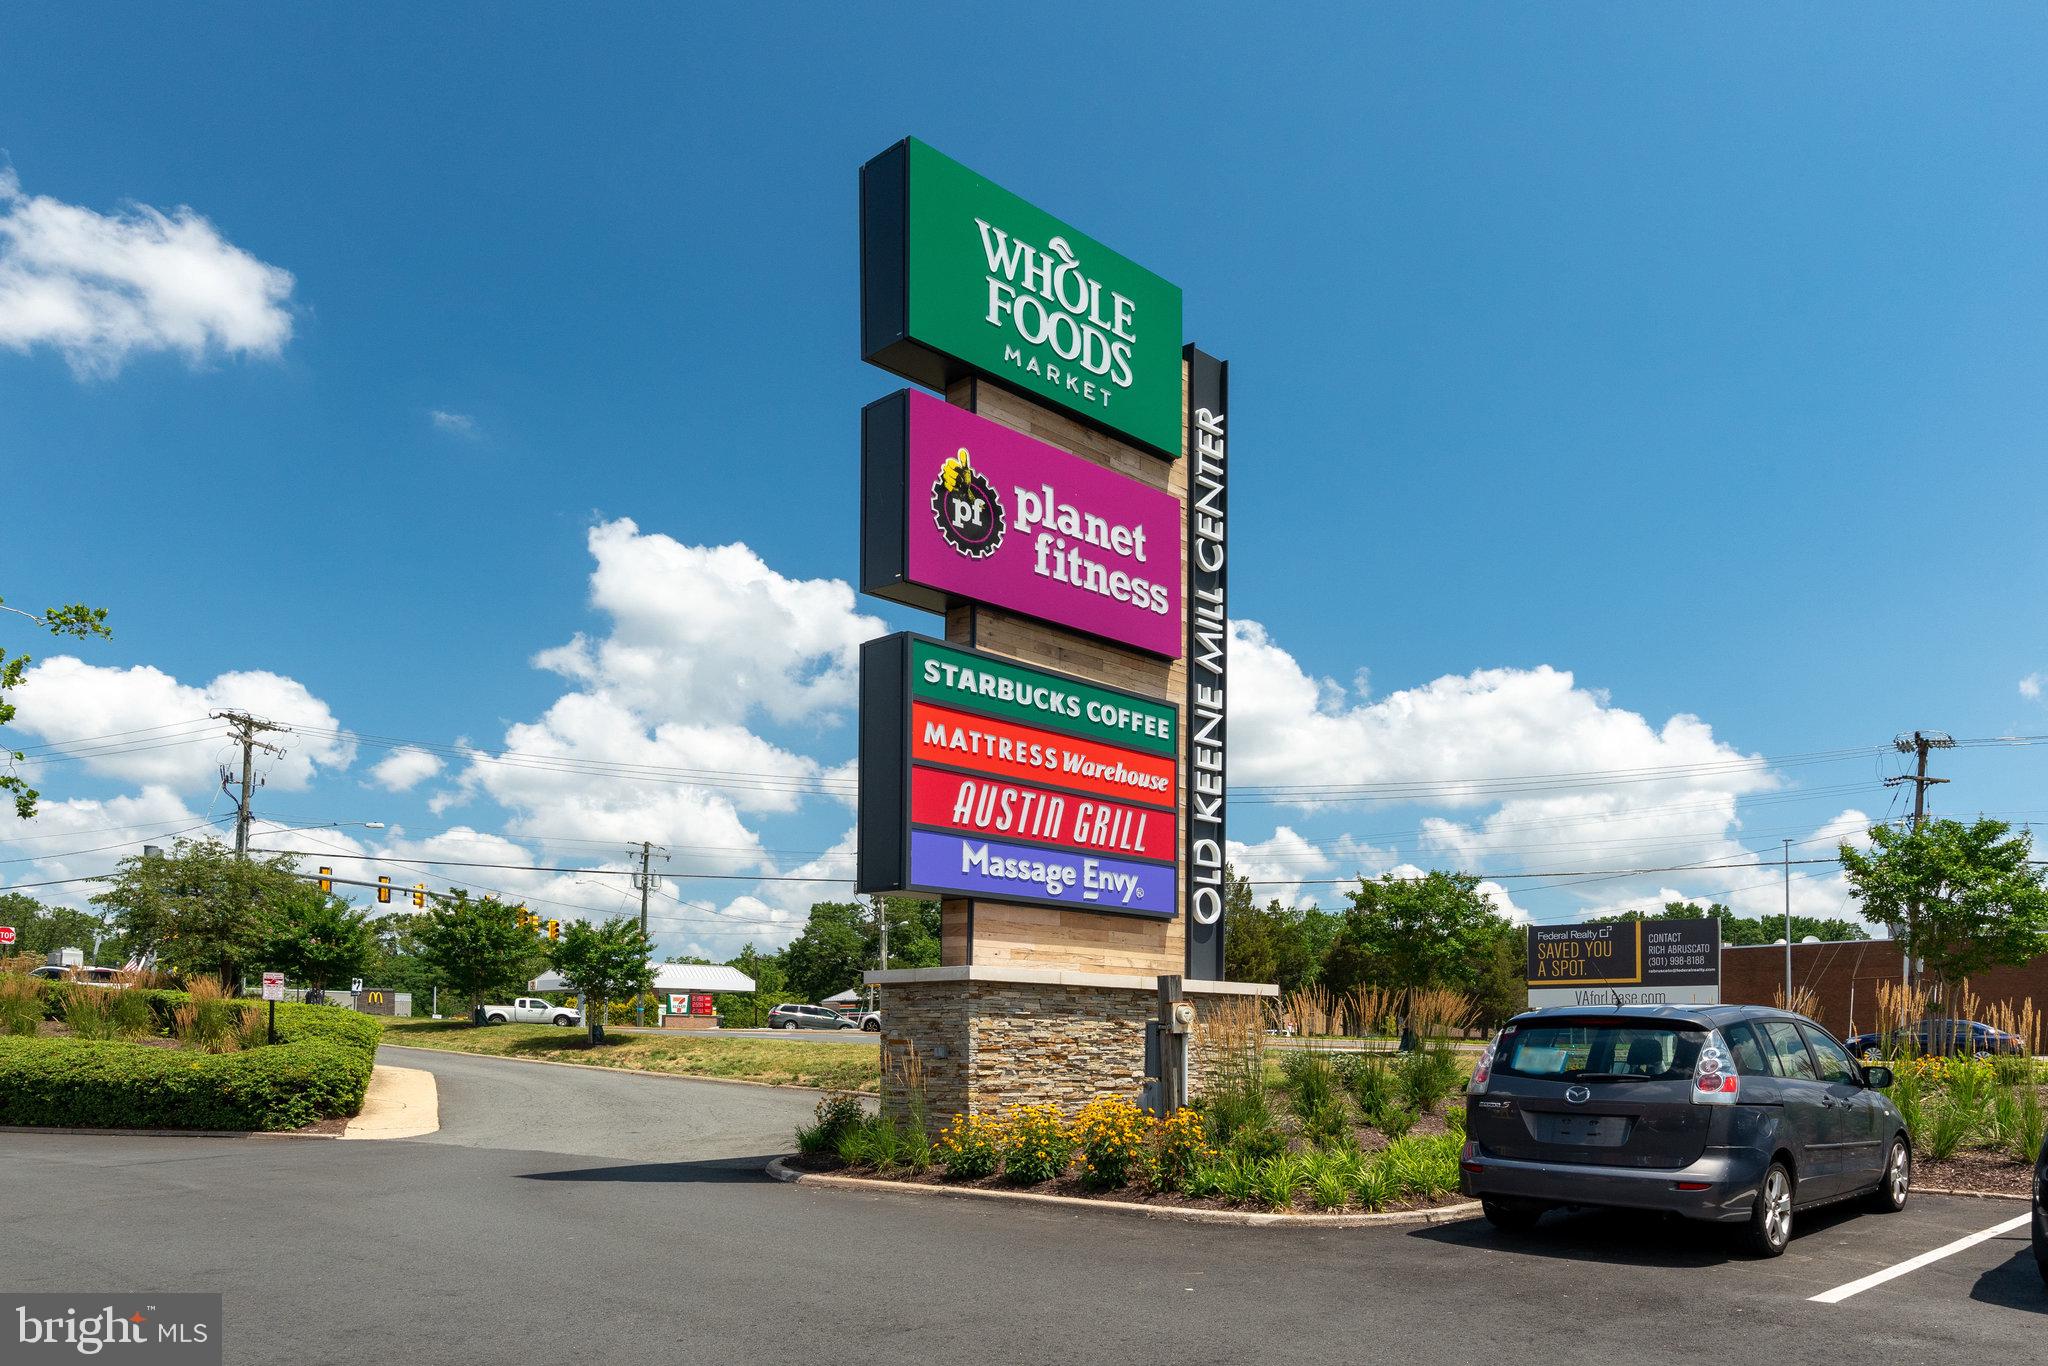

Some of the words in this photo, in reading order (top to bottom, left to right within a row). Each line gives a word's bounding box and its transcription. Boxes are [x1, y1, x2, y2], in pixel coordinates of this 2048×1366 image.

[975, 217, 1136, 343] WHOLE
[986, 276, 1133, 388] FOODS
[1004, 344, 1112, 407] MARKET
[952, 498, 986, 528] pf
[1014, 484, 1147, 562] planet
[1195, 407, 1225, 573] CENTER
[1034, 532, 1169, 615] fitness
[1195, 587, 1224, 674] MILL
[924, 659, 1080, 718] STARBUCKS
[1086, 701, 1170, 739] COFFEE
[923, 721, 1058, 769] MATTRESS
[1062, 750, 1169, 792] Warehouse
[1194, 683, 1223, 823] KEENE
[952, 781, 1065, 838] AUSTIN
[1074, 802, 1148, 852] GRILL
[962, 840, 1077, 895] Massage
[1193, 839, 1222, 925] OLD
[1538, 931, 1568, 940] Federal
[1570, 930, 1598, 940] Realty
[1538, 941, 1579, 960] SAVED
[1584, 940, 1612, 958] YOU
[1538, 960, 1546, 976] A
[1552, 960, 1587, 976] SPOT.
[1648, 932, 1682, 943] CONTACT
[1648, 946, 1666, 954] RICH
[1668, 944, 1710, 954] ABRUSCATO
[1648, 956, 1668, 967] (301)
[1670, 956, 1704, 966] 998-8188
